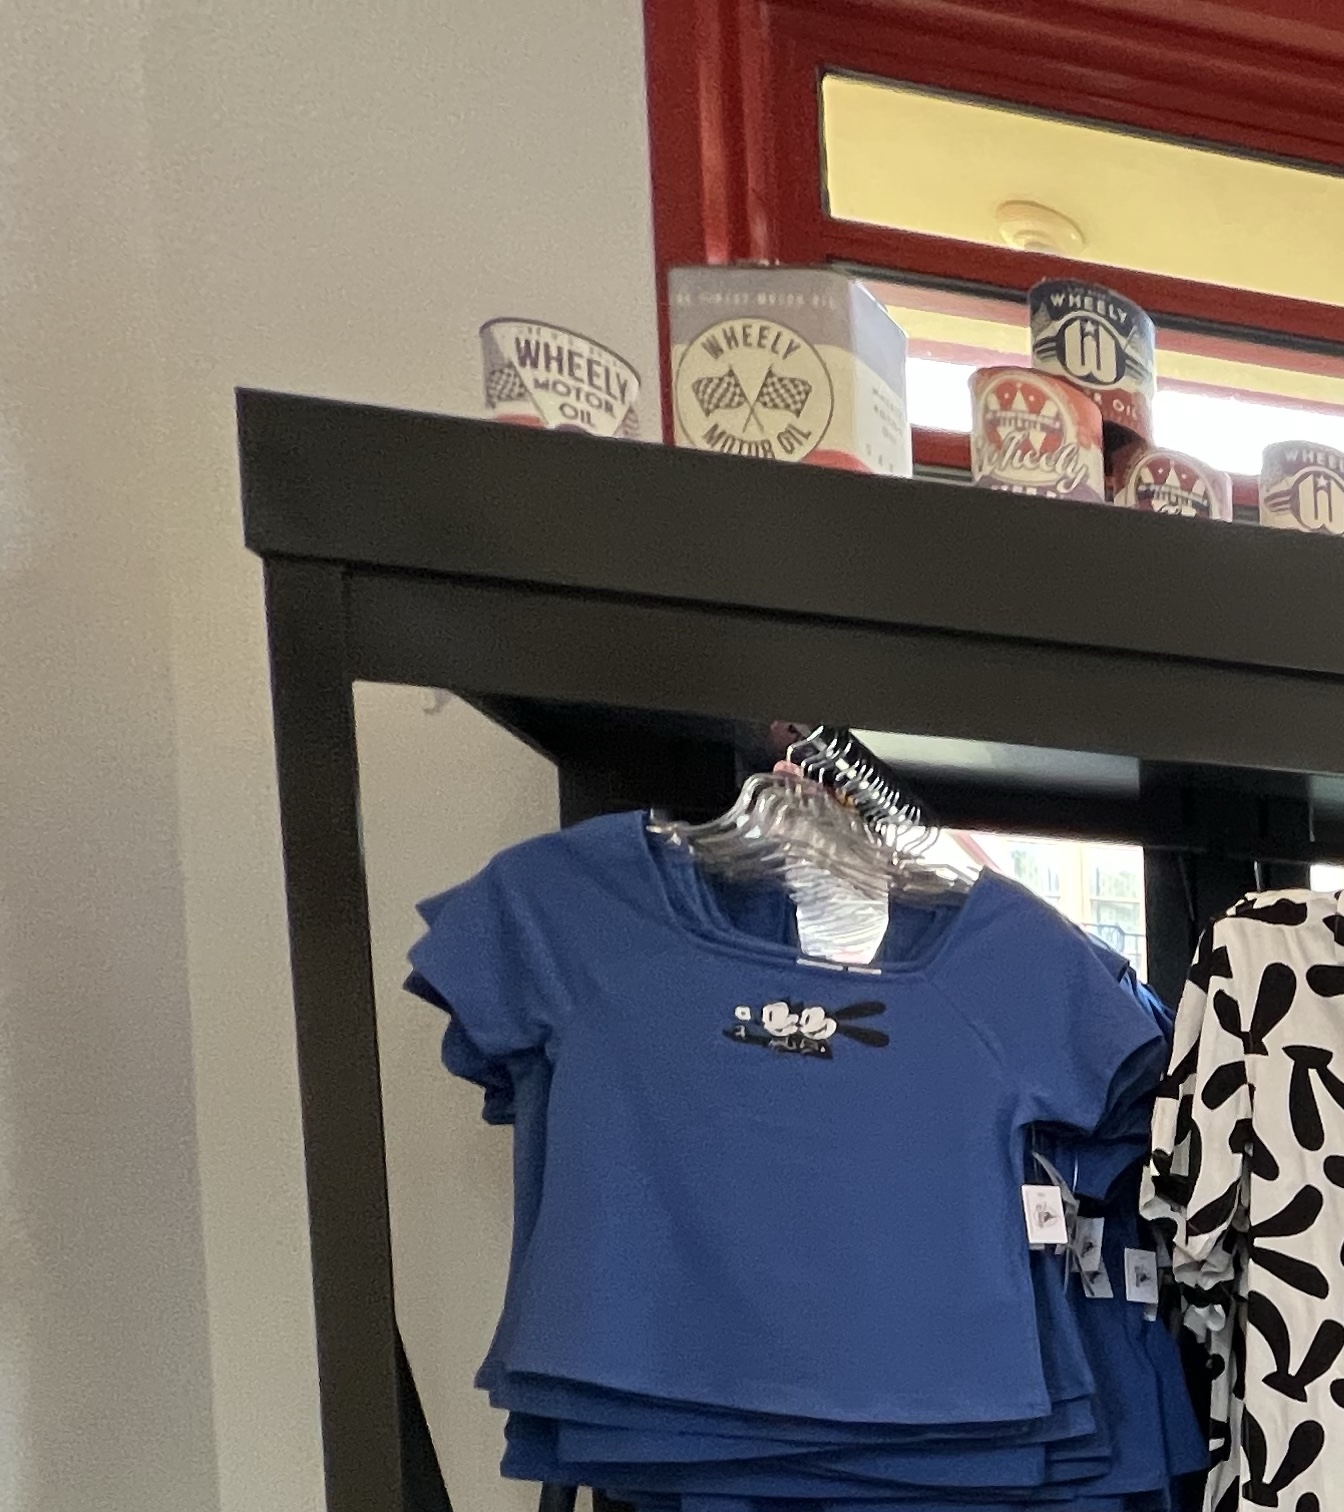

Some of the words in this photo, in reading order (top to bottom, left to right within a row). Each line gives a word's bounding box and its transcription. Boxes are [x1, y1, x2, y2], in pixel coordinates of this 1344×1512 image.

[1050, 293, 1128, 324] WHEELY
[701, 324, 801, 361] WHEELY
[514, 336, 628, 405] WHEELY
[533, 377, 617, 419] MOTOR
[559, 402, 596, 428] OIL
[776, 421, 812, 456] OIL
